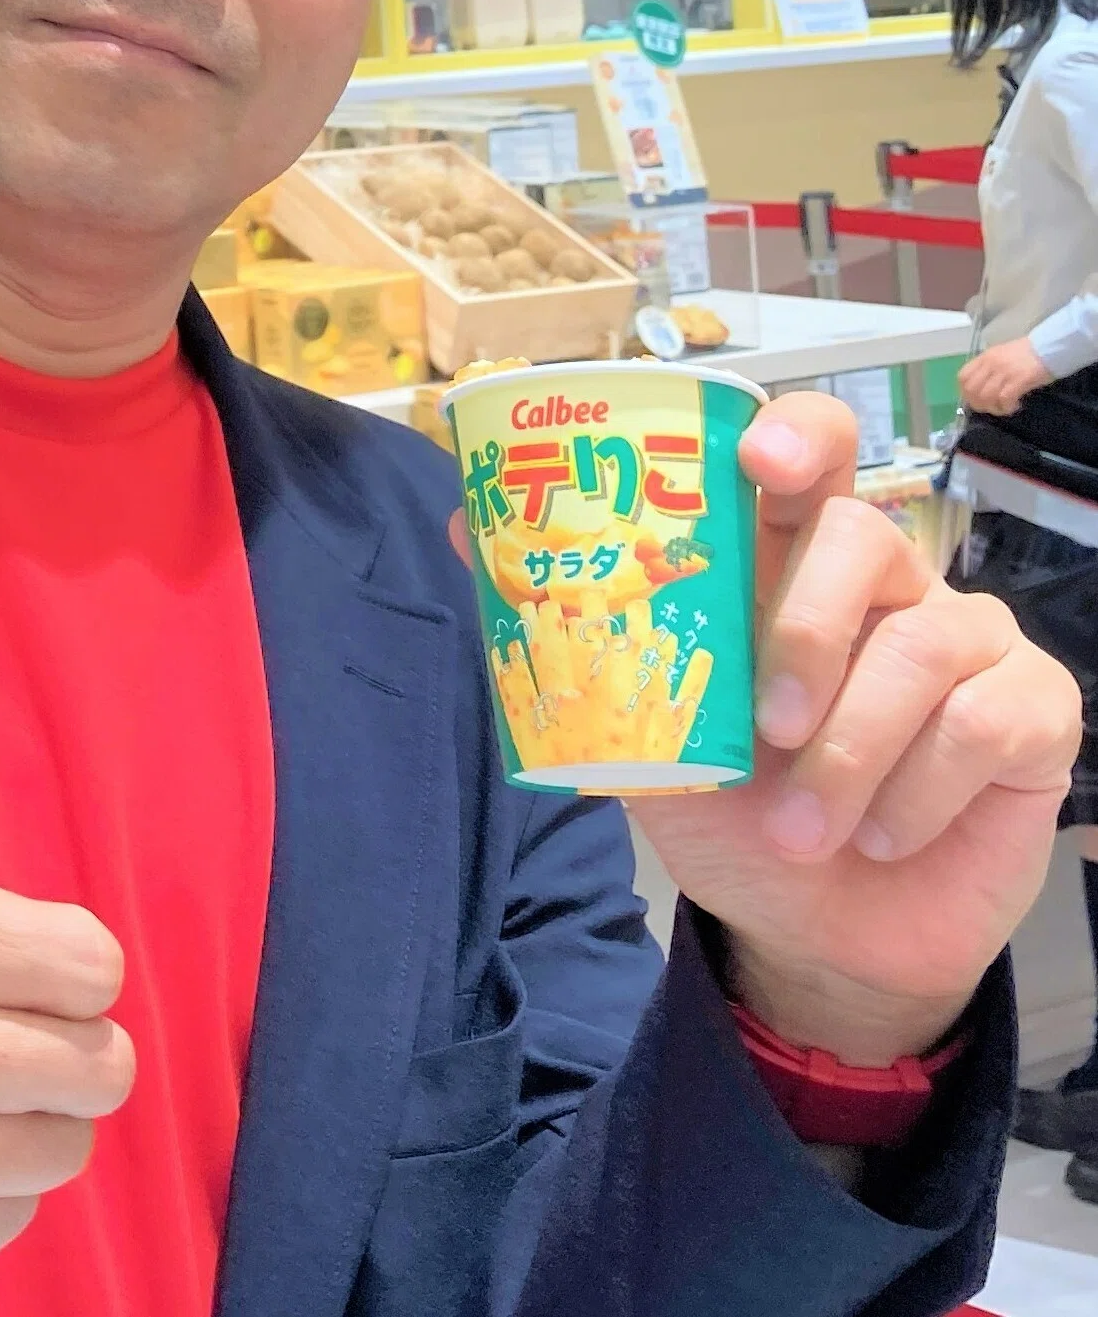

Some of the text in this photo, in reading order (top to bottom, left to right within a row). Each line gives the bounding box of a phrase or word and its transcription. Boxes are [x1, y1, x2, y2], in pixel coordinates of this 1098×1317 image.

[511, 395, 609, 430] Calbee
[465, 434, 705, 530] ポテりこ
[524, 542, 626, 588] サラダ
[666, 609, 709, 685] サクッて
